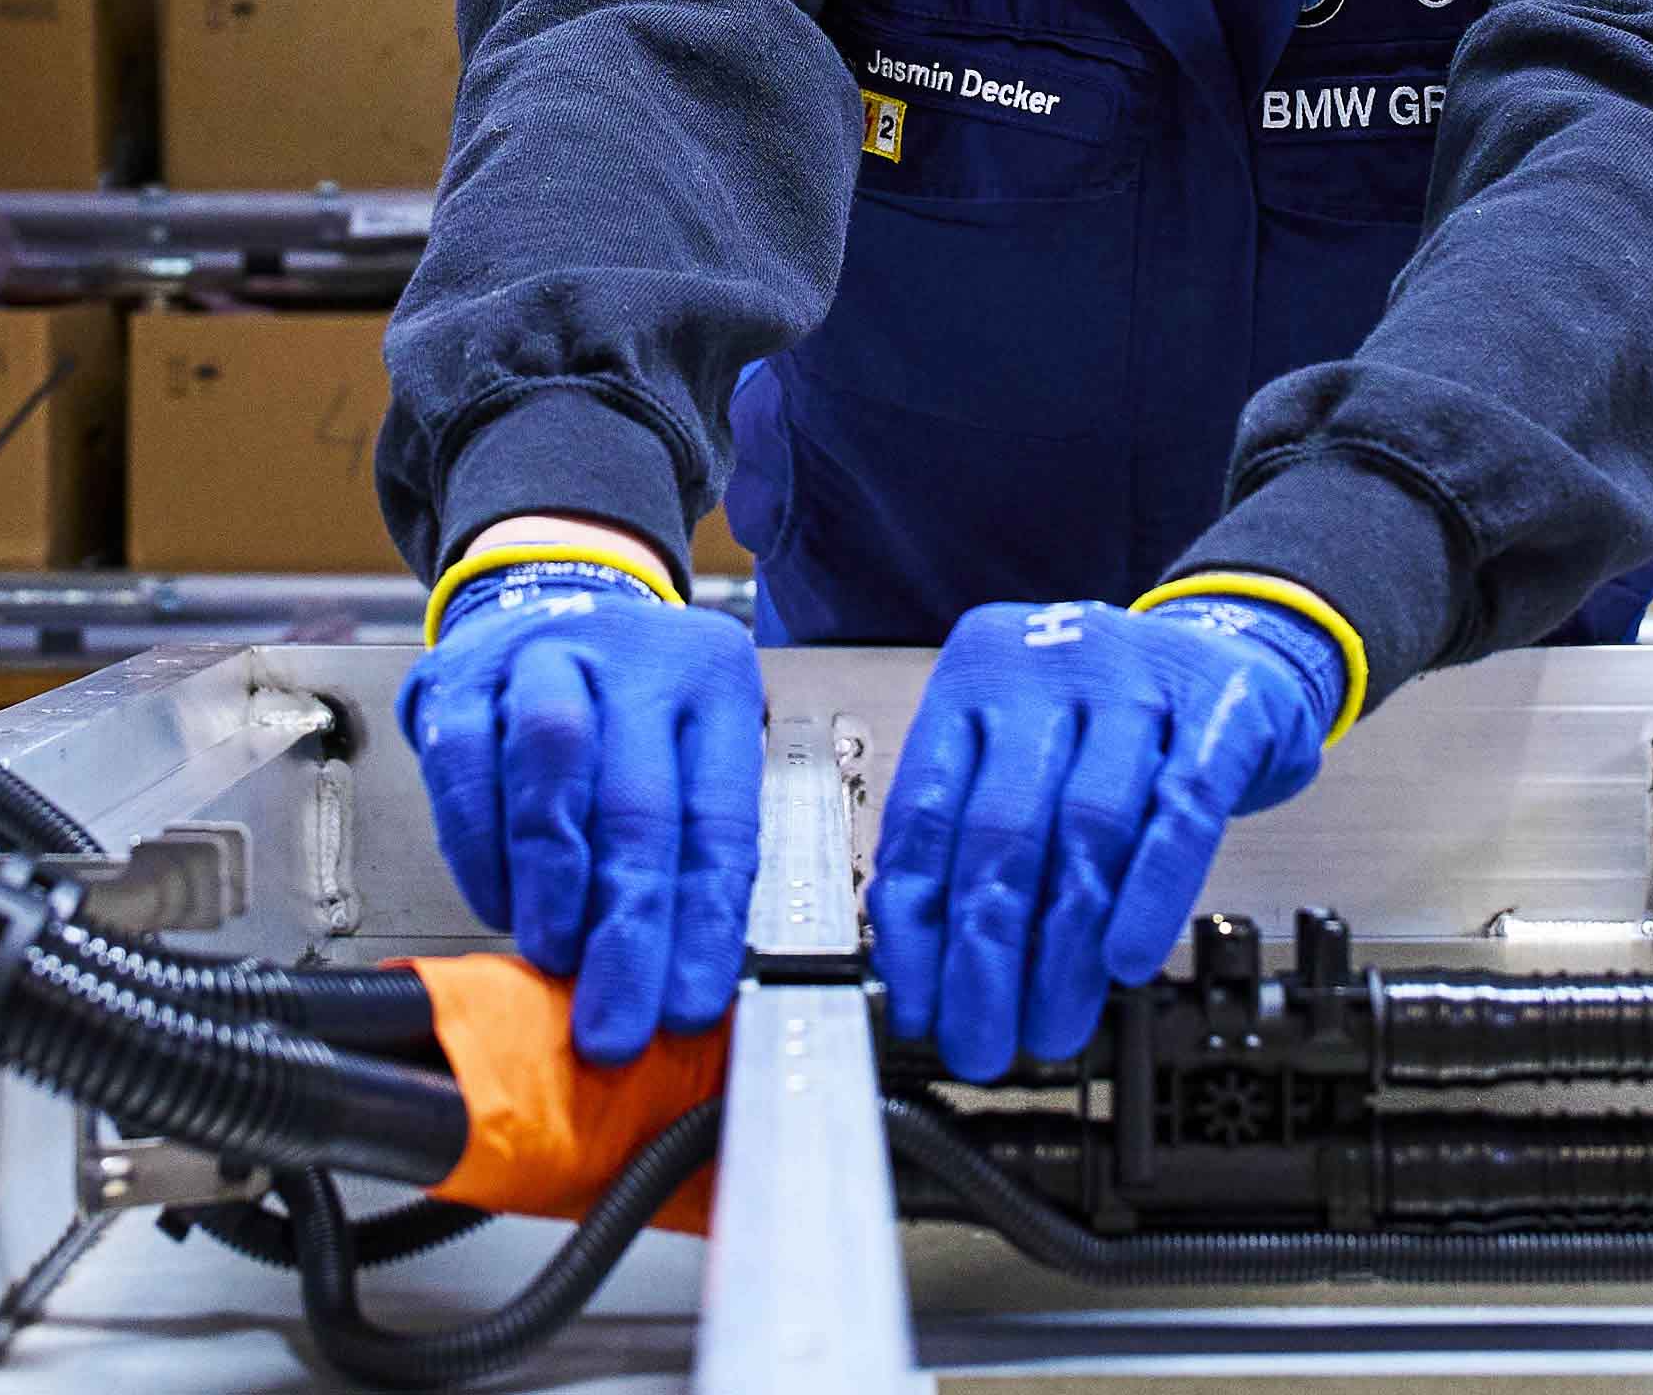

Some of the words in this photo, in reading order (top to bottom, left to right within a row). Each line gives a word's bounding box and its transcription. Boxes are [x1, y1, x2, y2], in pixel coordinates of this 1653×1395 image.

[867, 49, 954, 93] Jasmin
[959, 68, 1061, 116] Decker
[878, 114, 894, 140] 2
[1262, 86, 1377, 130] BMW
